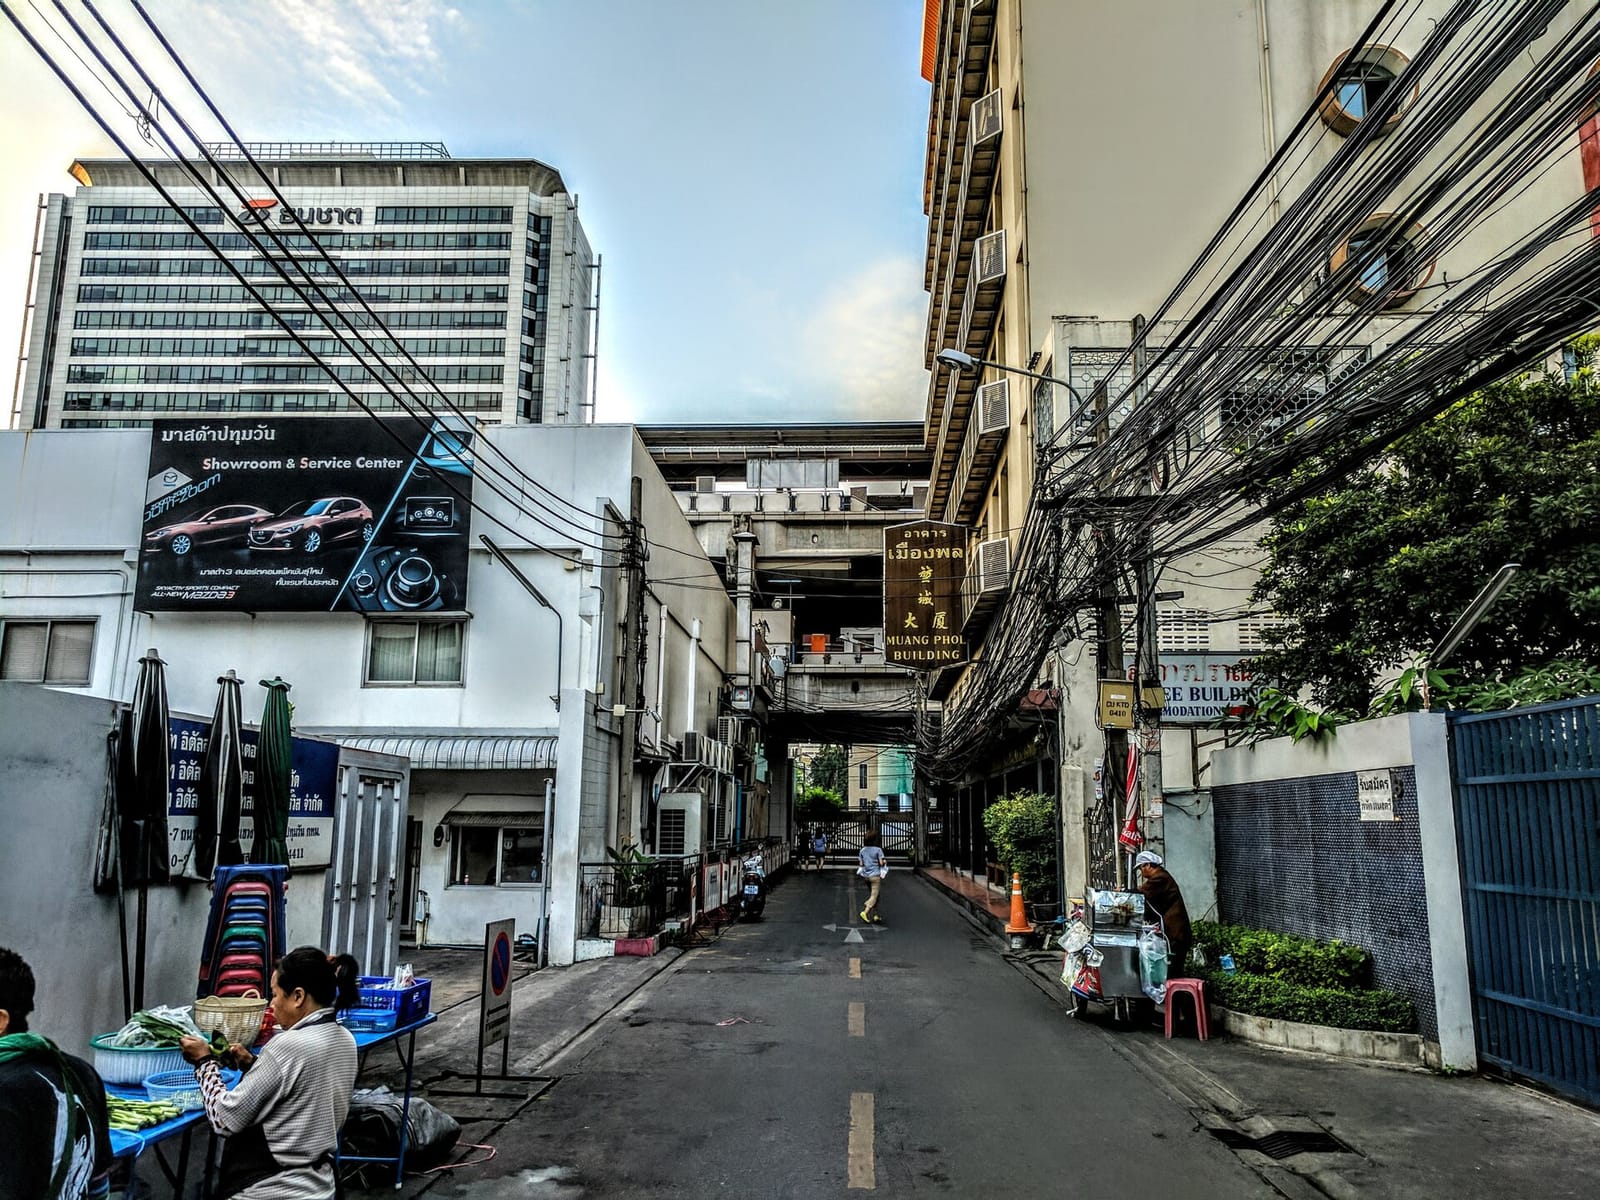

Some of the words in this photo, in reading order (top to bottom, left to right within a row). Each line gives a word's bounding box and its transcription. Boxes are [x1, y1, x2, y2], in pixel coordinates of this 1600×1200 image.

[162, 424, 275, 445] มาสด้าปทุมวัน
[203, 457, 281, 470] Showroom
[286, 458, 296, 469] &
[300, 457, 351, 470] Service
[356, 456, 403, 469] Center
[904, 530, 947, 538] อาคาร
[888, 542, 963, 560] เมืองพล
[887, 635, 929, 645] MUANG
[934, 635, 966, 645] PHOL
[894, 650, 960, 661] BUILDING
[1162, 706, 1222, 717] MODATION
